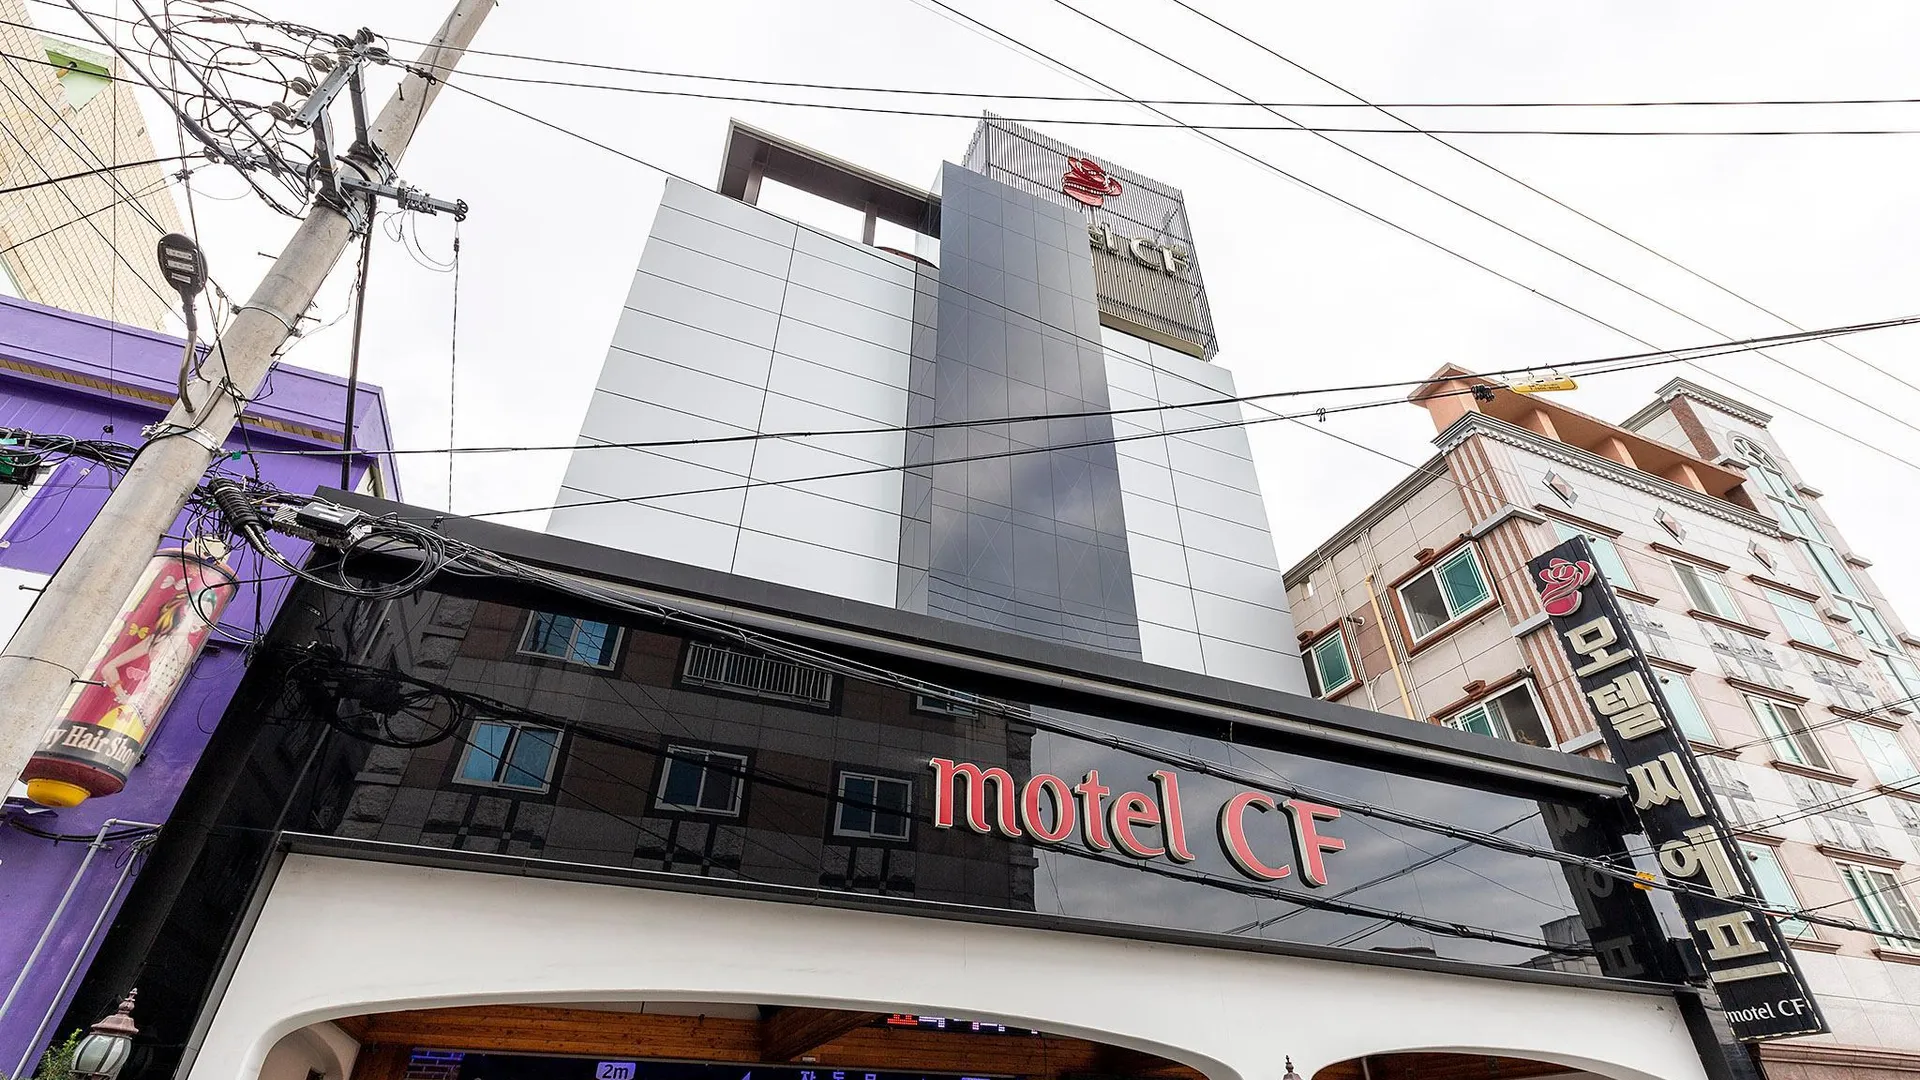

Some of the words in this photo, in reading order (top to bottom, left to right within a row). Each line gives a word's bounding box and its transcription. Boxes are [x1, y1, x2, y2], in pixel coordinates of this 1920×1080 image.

[1130, 237, 1188, 273] CF
[62, 725, 109, 753] Hair
[929, 757, 1195, 864] motel
[1216, 791, 1346, 886] CF
[1727, 1002, 1776, 1023] motel
[1777, 998, 1805, 1017] CF
[602, 1064, 629, 1080] 2m
